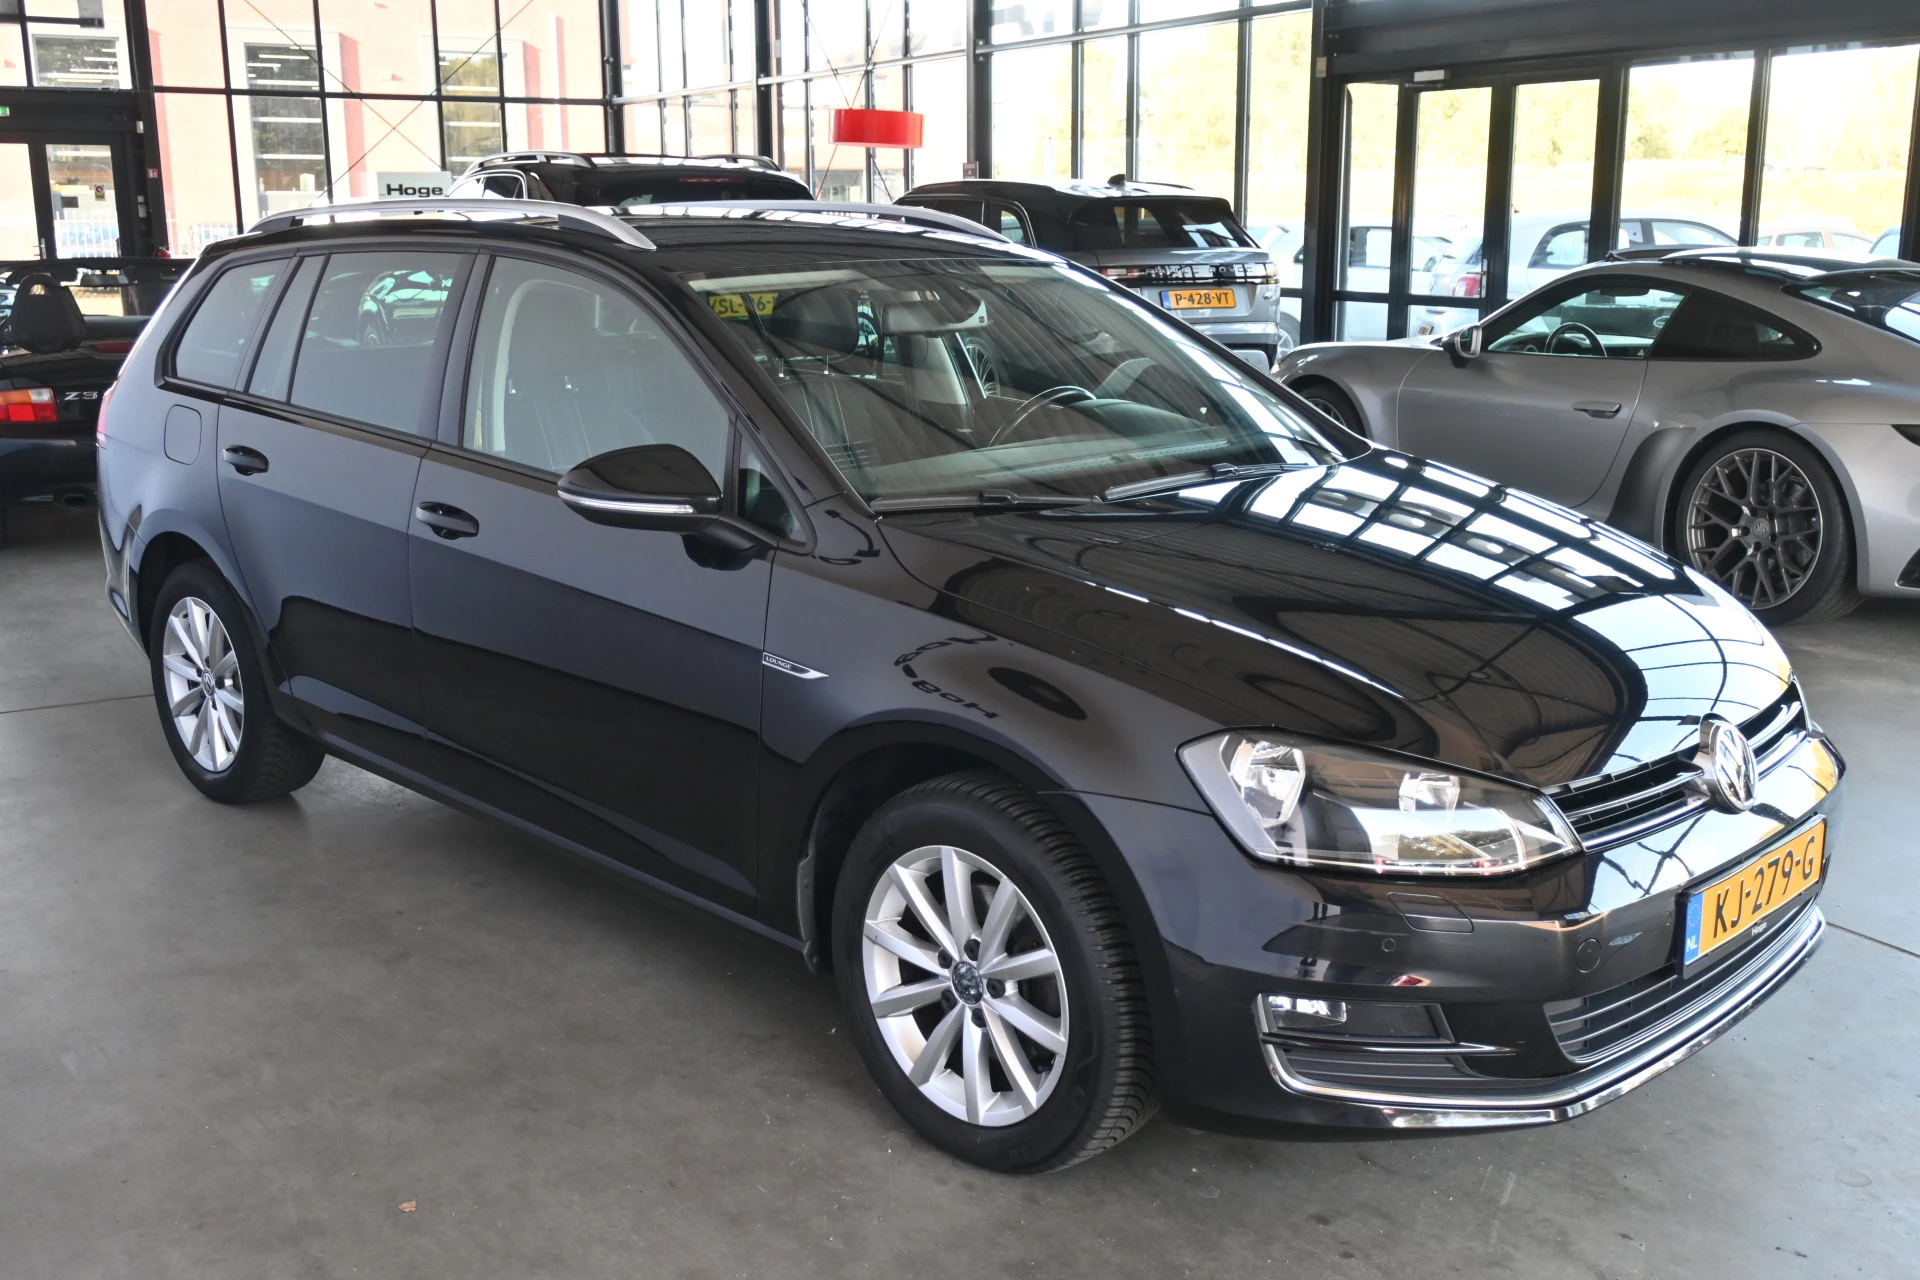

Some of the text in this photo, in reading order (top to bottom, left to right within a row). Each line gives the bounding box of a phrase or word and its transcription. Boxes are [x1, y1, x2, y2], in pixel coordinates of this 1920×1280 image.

[386, 183, 444, 198] Hoge
[710, 294, 778, 316] SL-6-
[1174, 292, 1230, 306] P-428-VT
[64, 391, 98, 401] Z3
[765, 655, 793, 670] LOUNGE
[1713, 835, 1815, 939] KJ-279-G
[1686, 934, 1698, 953] NL
